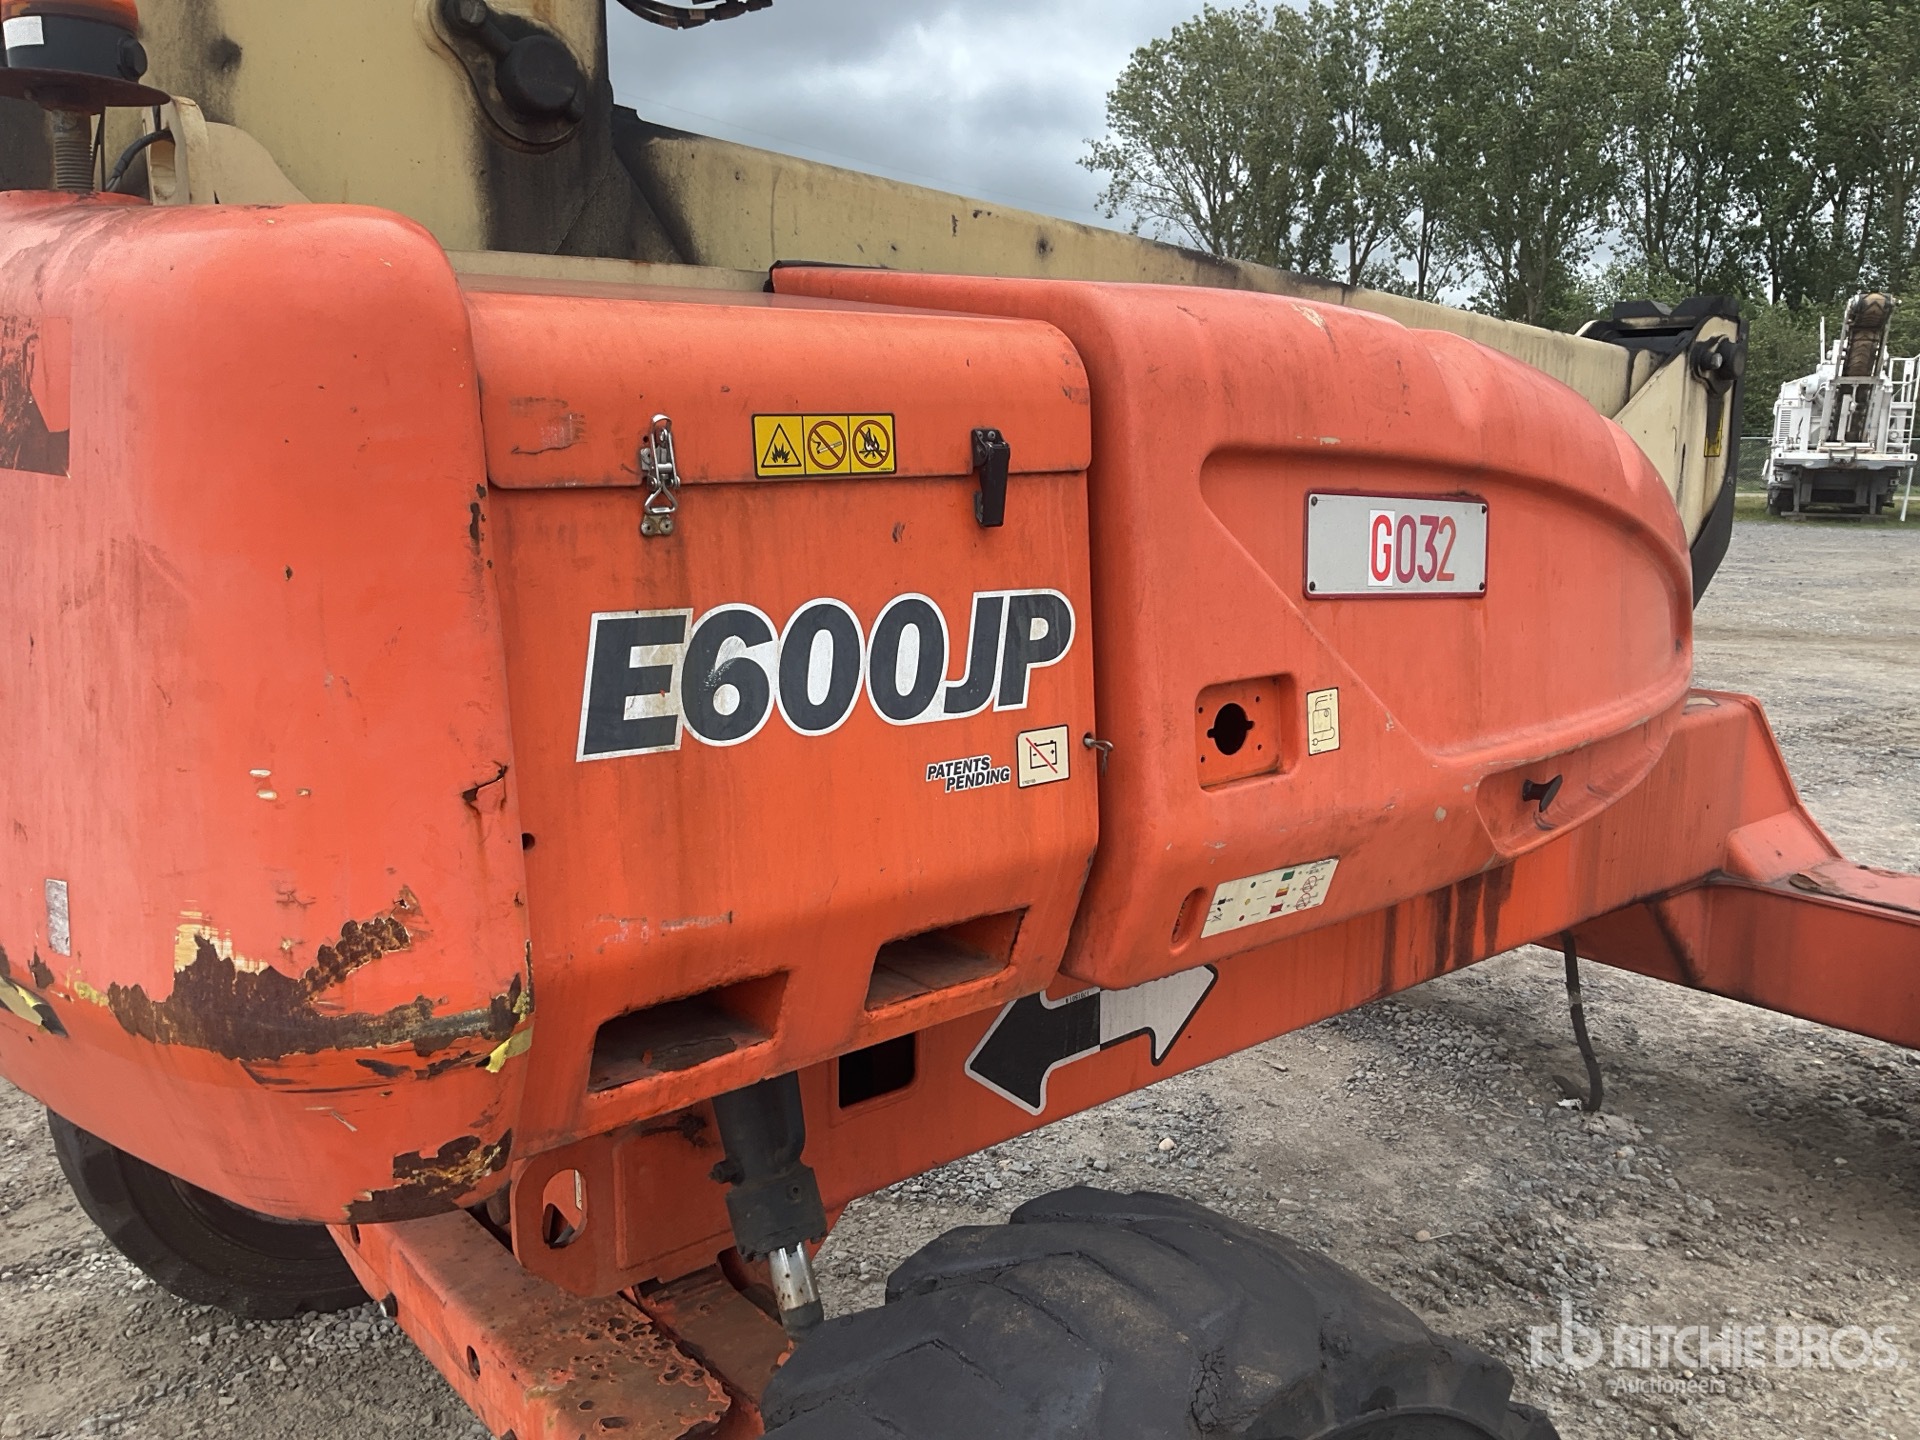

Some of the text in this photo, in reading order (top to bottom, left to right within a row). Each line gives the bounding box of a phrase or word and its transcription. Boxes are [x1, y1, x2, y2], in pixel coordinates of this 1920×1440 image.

[1371, 515, 1457, 583] G032
[578, 590, 1074, 760] E600JP
[926, 755, 992, 781] PATENTS
[945, 767, 1011, 792] PENDING
